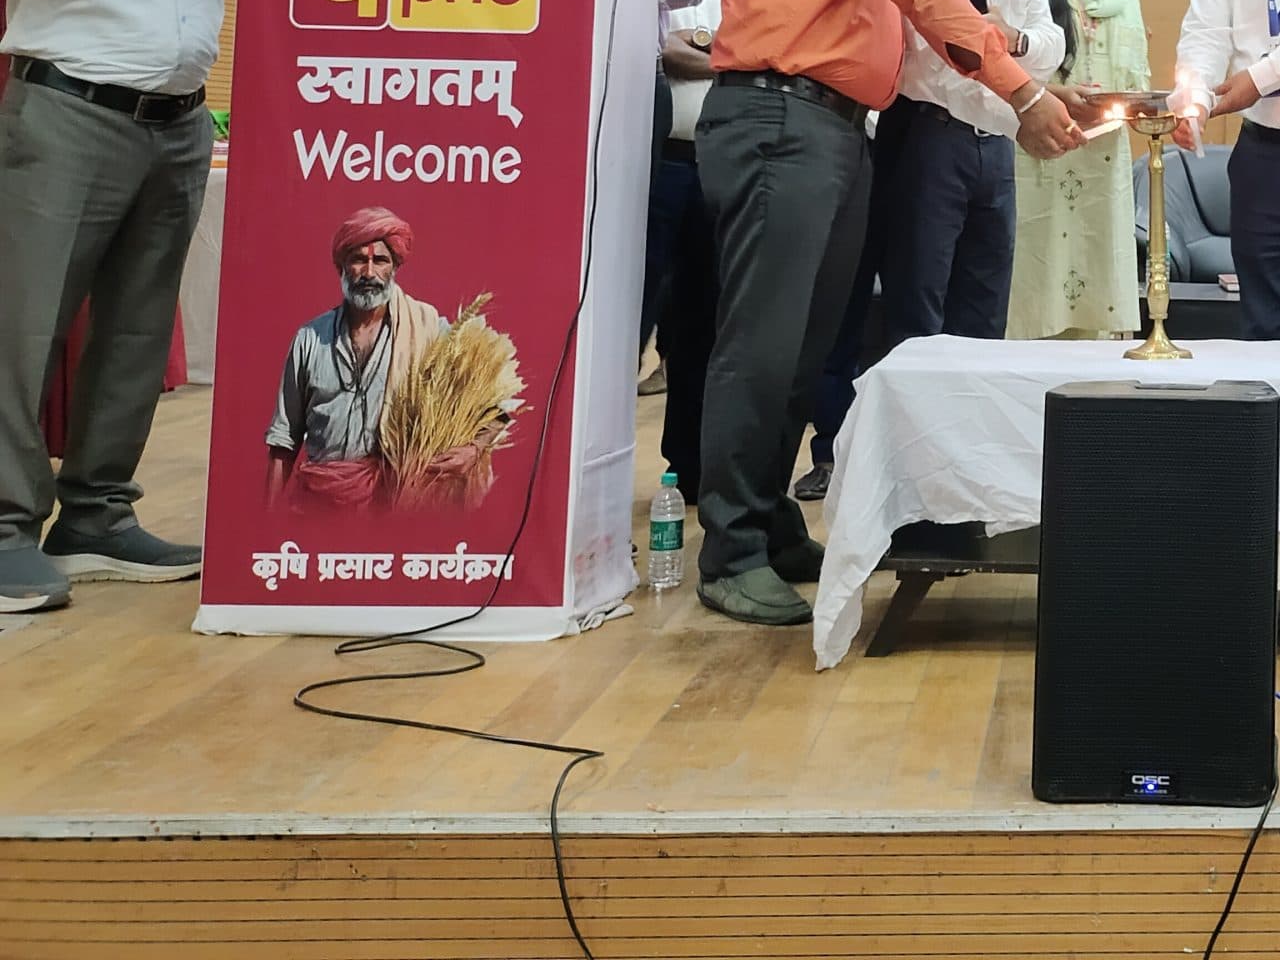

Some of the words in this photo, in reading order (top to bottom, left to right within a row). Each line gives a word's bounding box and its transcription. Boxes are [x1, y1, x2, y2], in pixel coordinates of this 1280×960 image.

[296, 55, 524, 129] स्वागतम्
[292, 128, 522, 184] Welcome
[252, 541, 309, 591] कृषि
[317, 553, 394, 582] प्रसार
[402, 542, 515, 584] कार्यक्रम
[1131, 775, 1170, 785] QSC
